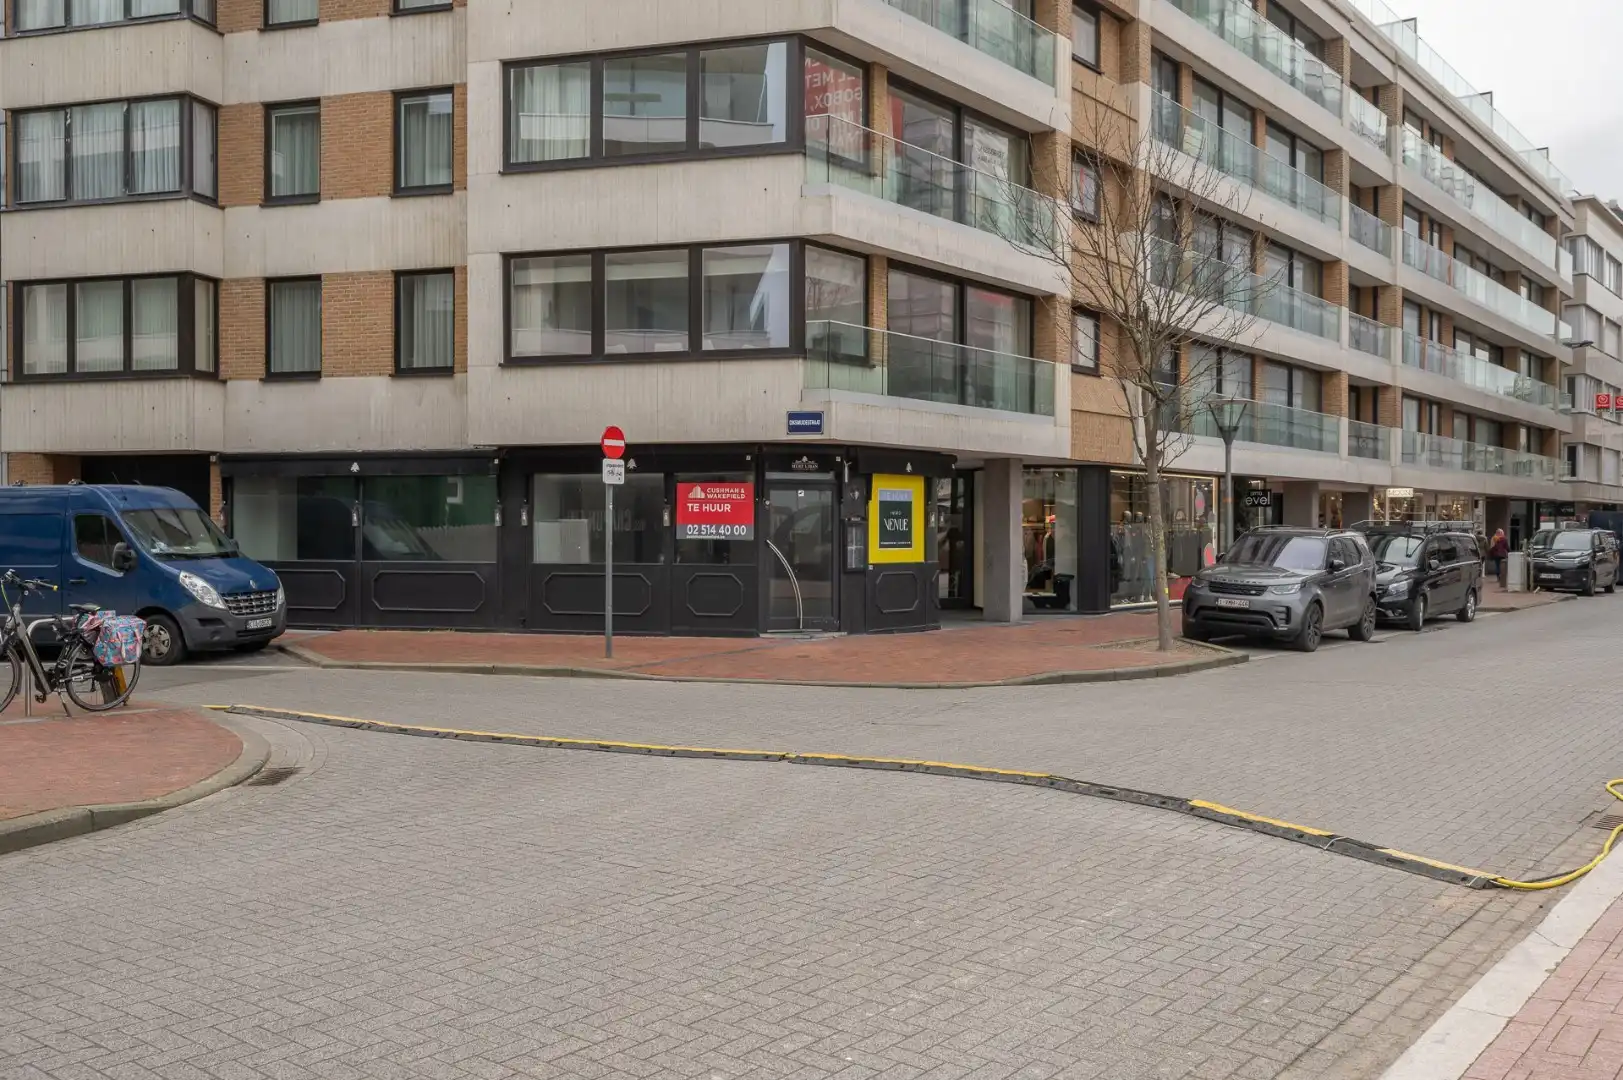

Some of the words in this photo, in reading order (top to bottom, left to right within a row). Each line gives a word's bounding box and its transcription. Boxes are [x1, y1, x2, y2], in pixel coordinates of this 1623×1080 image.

[1245, 491, 1270, 505] evel
[687, 503, 700, 512] TE
[702, 503, 731, 512] HUUR
[687, 524, 698, 535] 02
[701, 524, 716, 535] 514
[718, 525, 731, 535] 40
[734, 525, 747, 536] 00
[884, 518, 908, 531] VENUE
